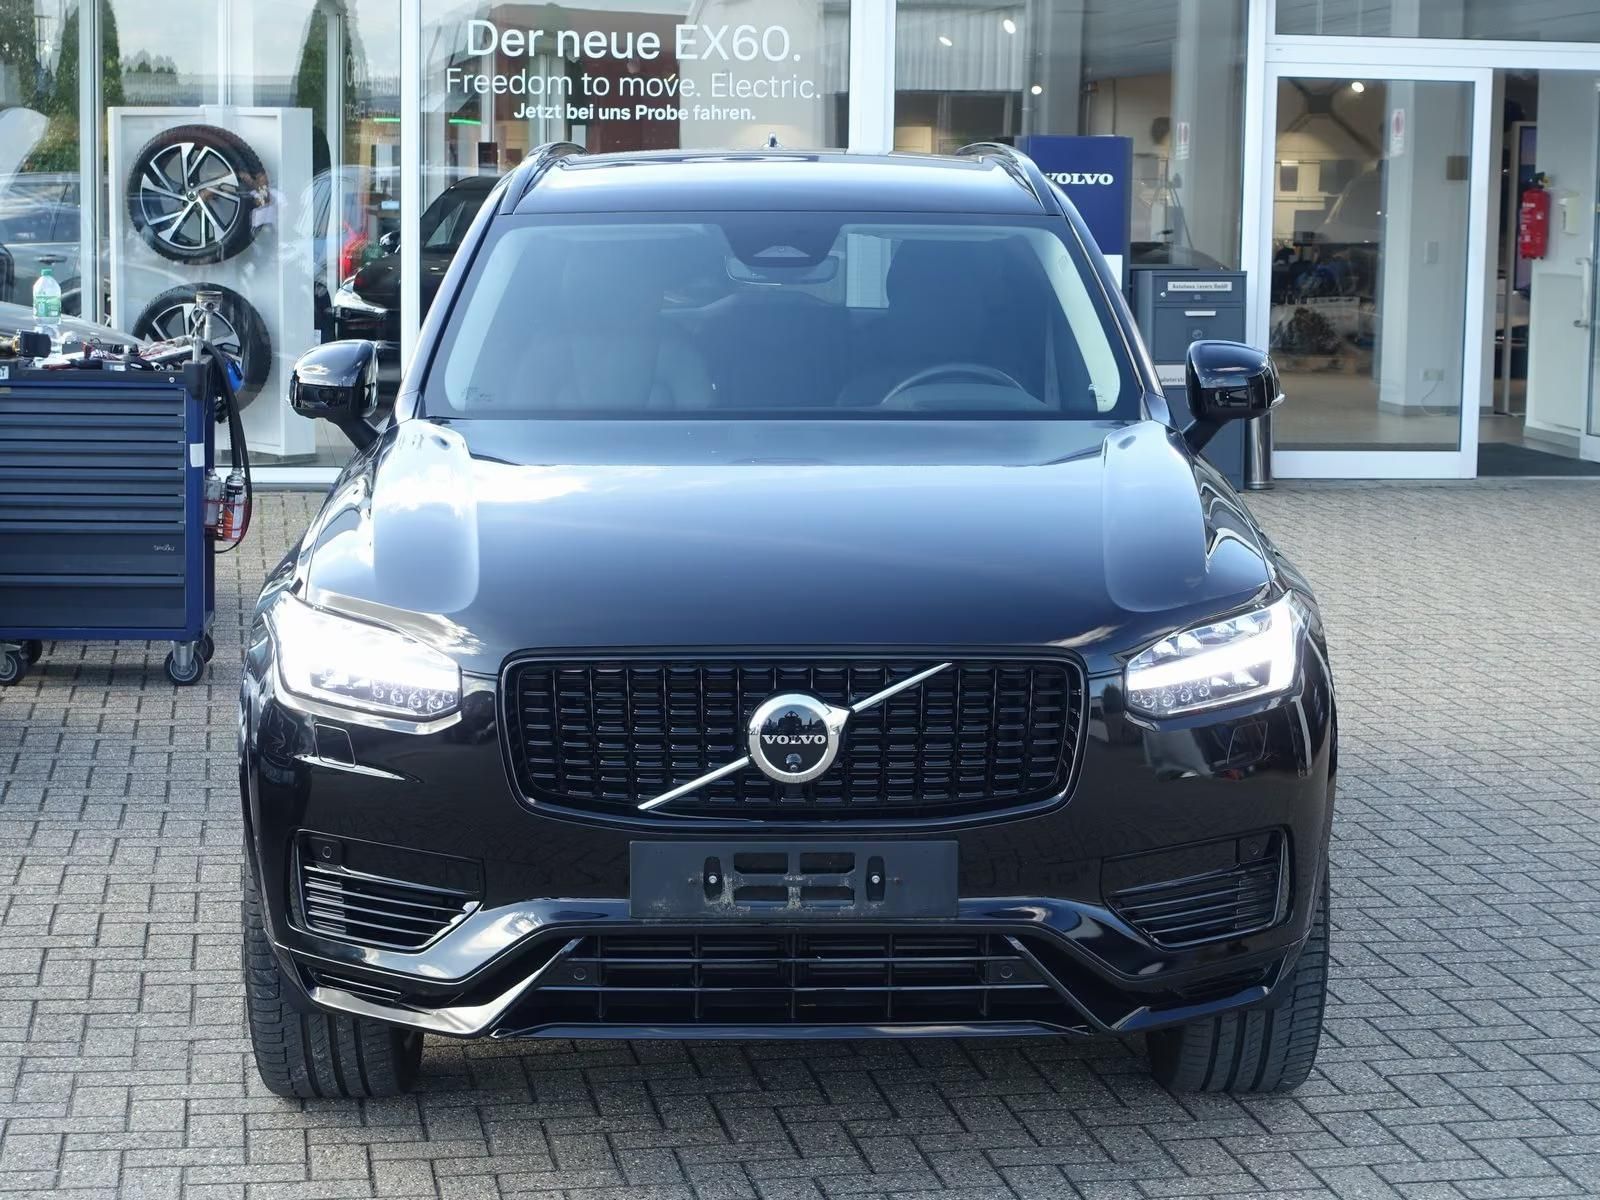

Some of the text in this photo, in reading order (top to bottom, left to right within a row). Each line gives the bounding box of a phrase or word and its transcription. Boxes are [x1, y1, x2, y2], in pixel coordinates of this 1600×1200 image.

[467, 19, 802, 63] Der neue EX60.
[446, 67, 822, 100] Freedom to move. Electric.
[513, 103, 757, 121] Jetzt bei uns Probe fahren.
[762, 734, 826, 745] VOLVO
